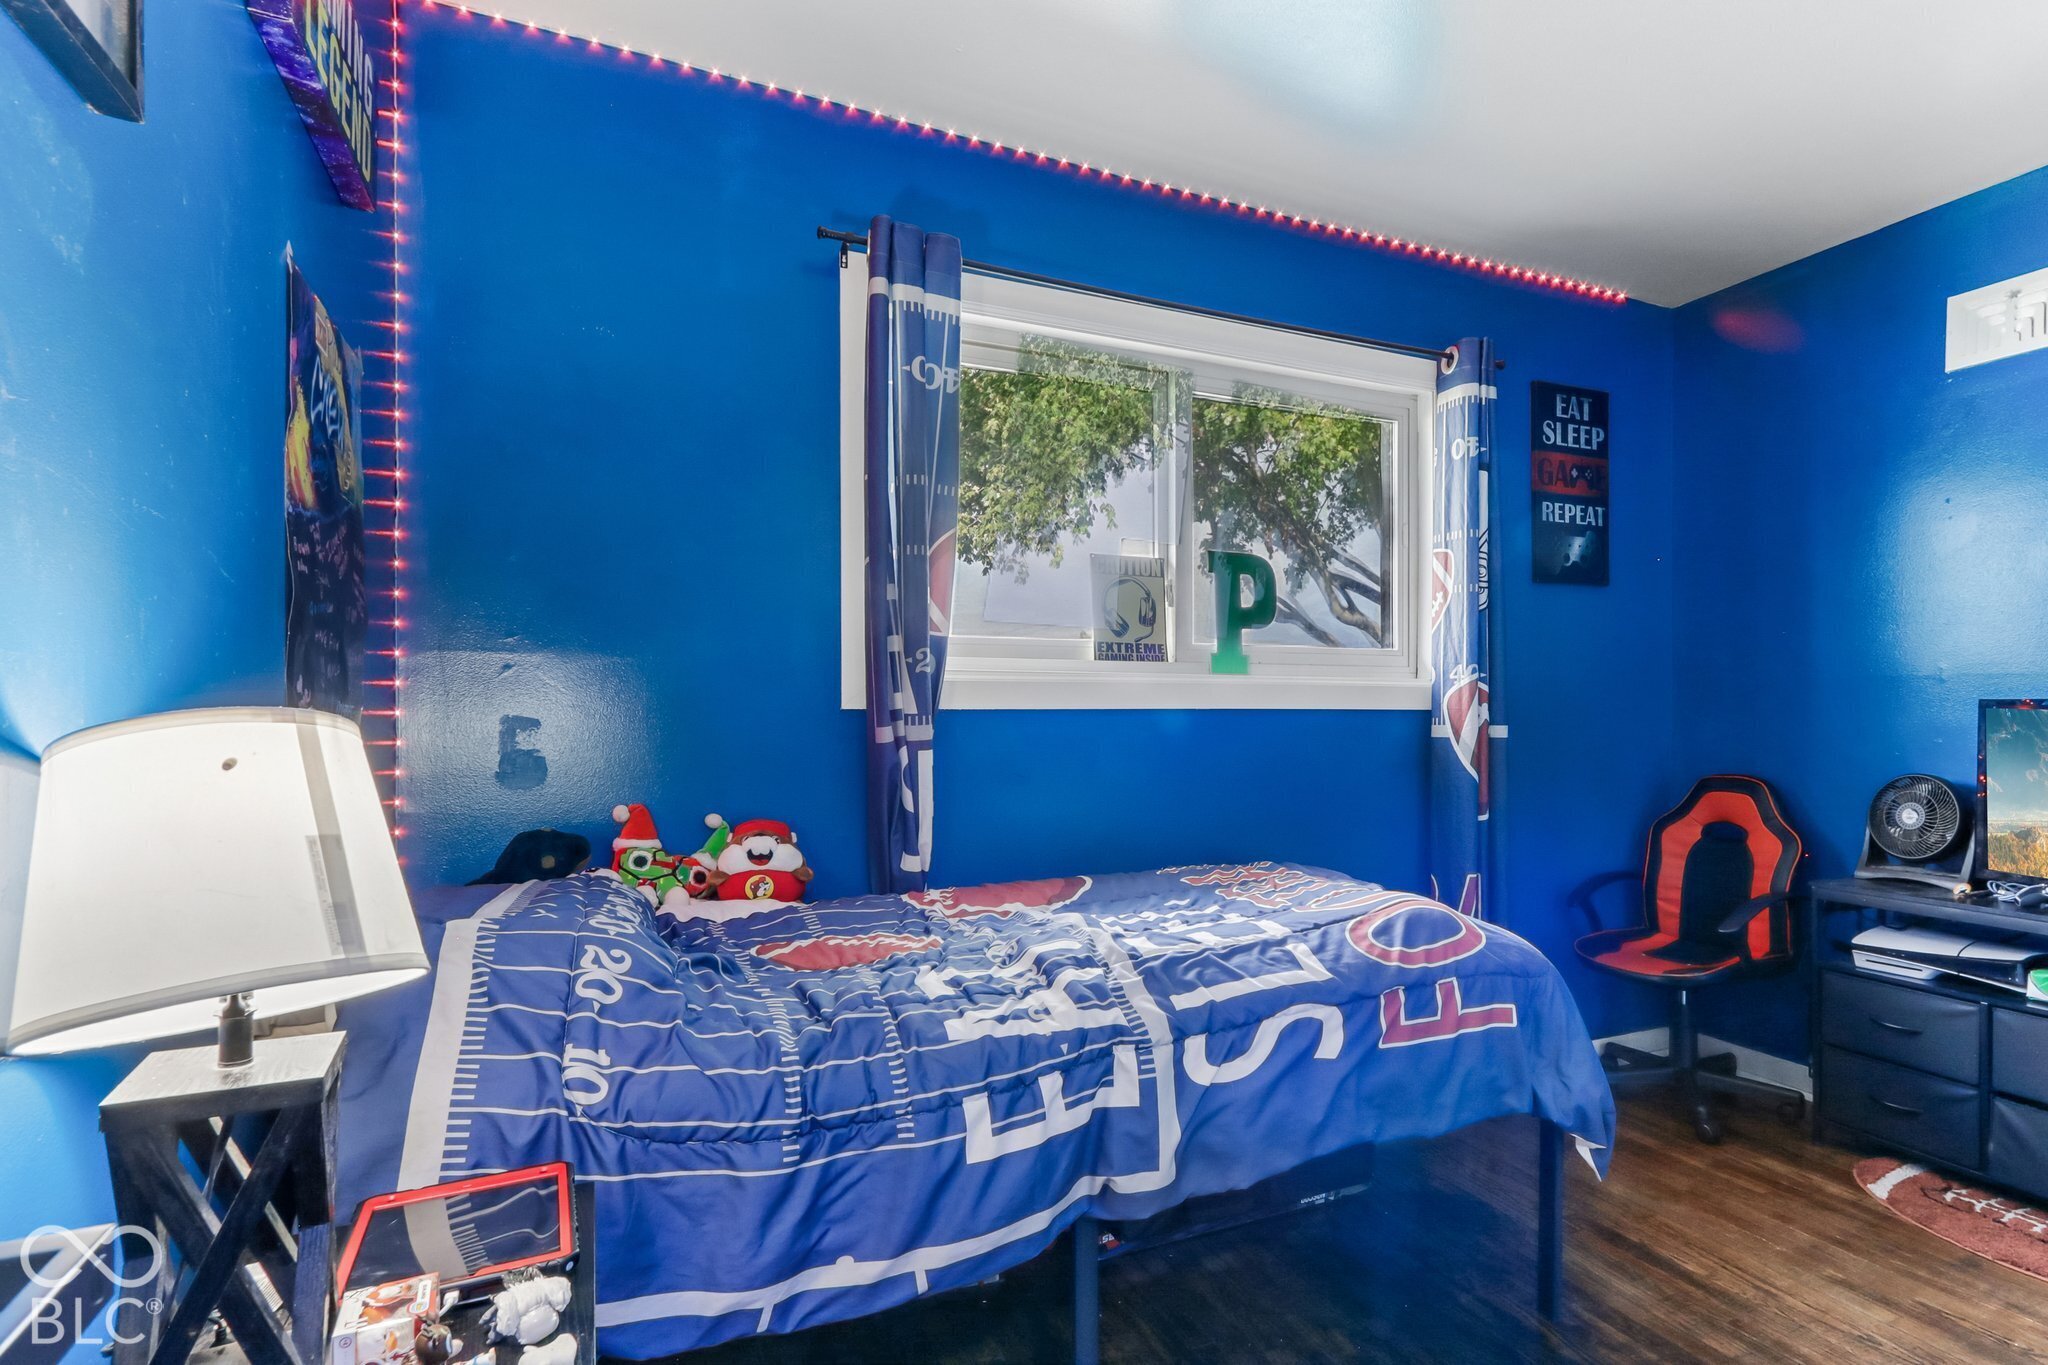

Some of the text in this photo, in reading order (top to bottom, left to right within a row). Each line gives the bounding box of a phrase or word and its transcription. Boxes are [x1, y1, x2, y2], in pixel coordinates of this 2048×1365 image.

[305, 0, 372, 183] LEGEND
[1556, 393, 1593, 422] EAT
[1542, 419, 1605, 451] SLEEP
[1541, 501, 1606, 527] REPEAT
[1207, 550, 1279, 675] P
[1097, 641, 1166, 655] EXTREME
[1097, 652, 1166, 663] GAMING INSIDE
[575, 944, 633, 1005] 20
[562, 1043, 610, 1106] 10
